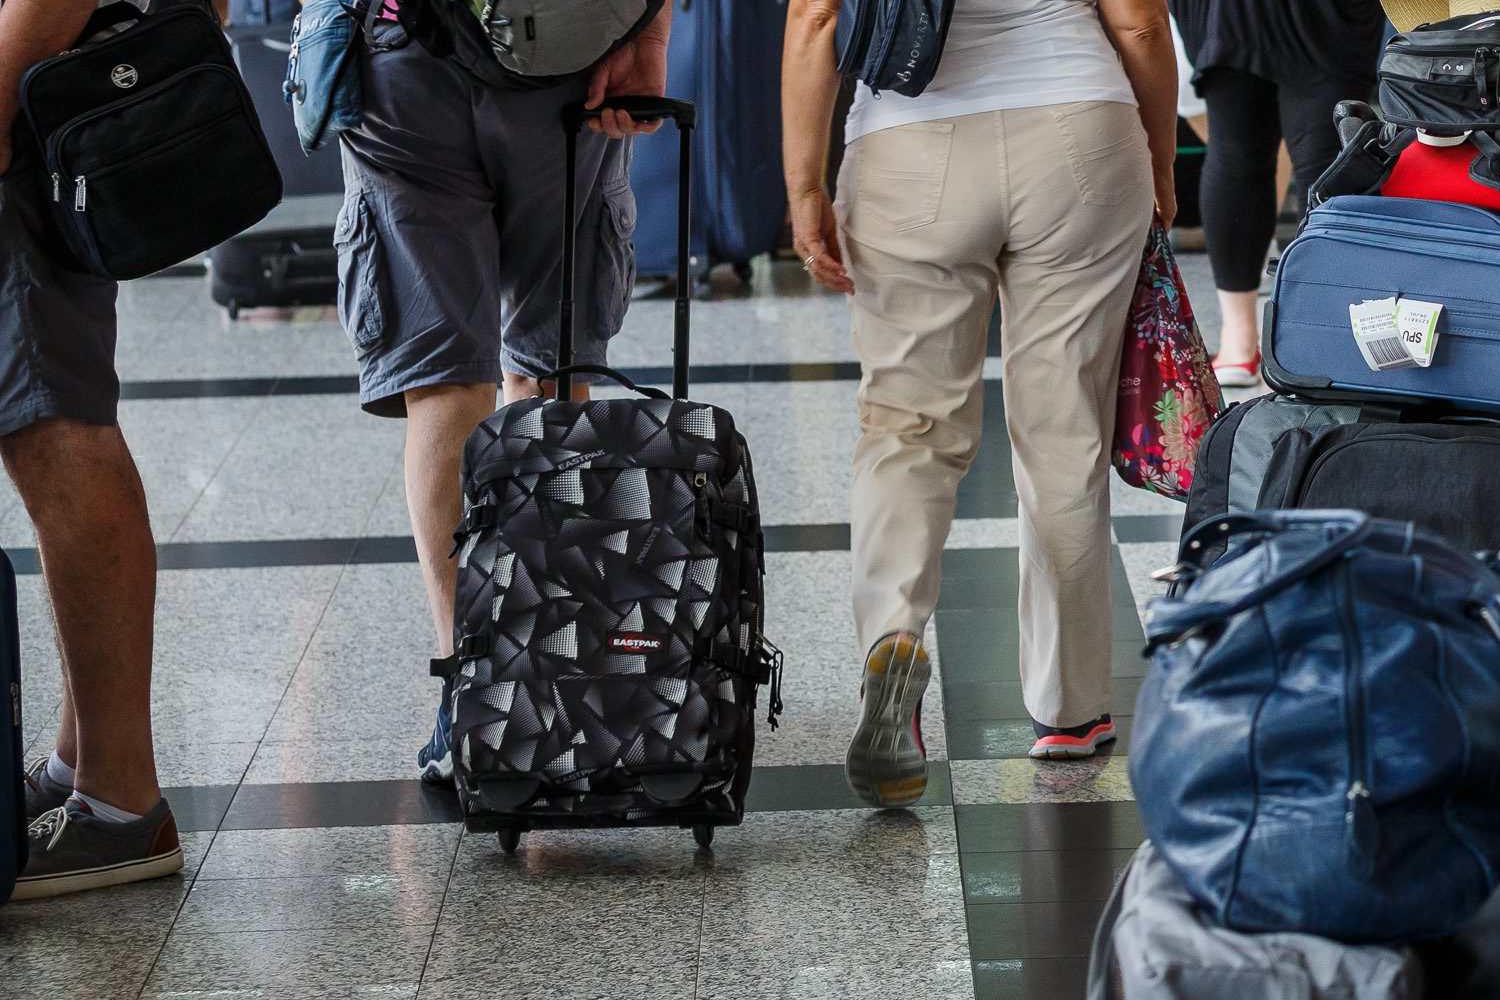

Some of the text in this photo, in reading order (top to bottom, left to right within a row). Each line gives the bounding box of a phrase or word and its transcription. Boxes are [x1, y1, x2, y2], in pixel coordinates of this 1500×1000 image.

[1402, 330, 1423, 344] SPU
[558, 449, 605, 470] EASTPAK
[613, 638, 660, 648] EASTPAK
